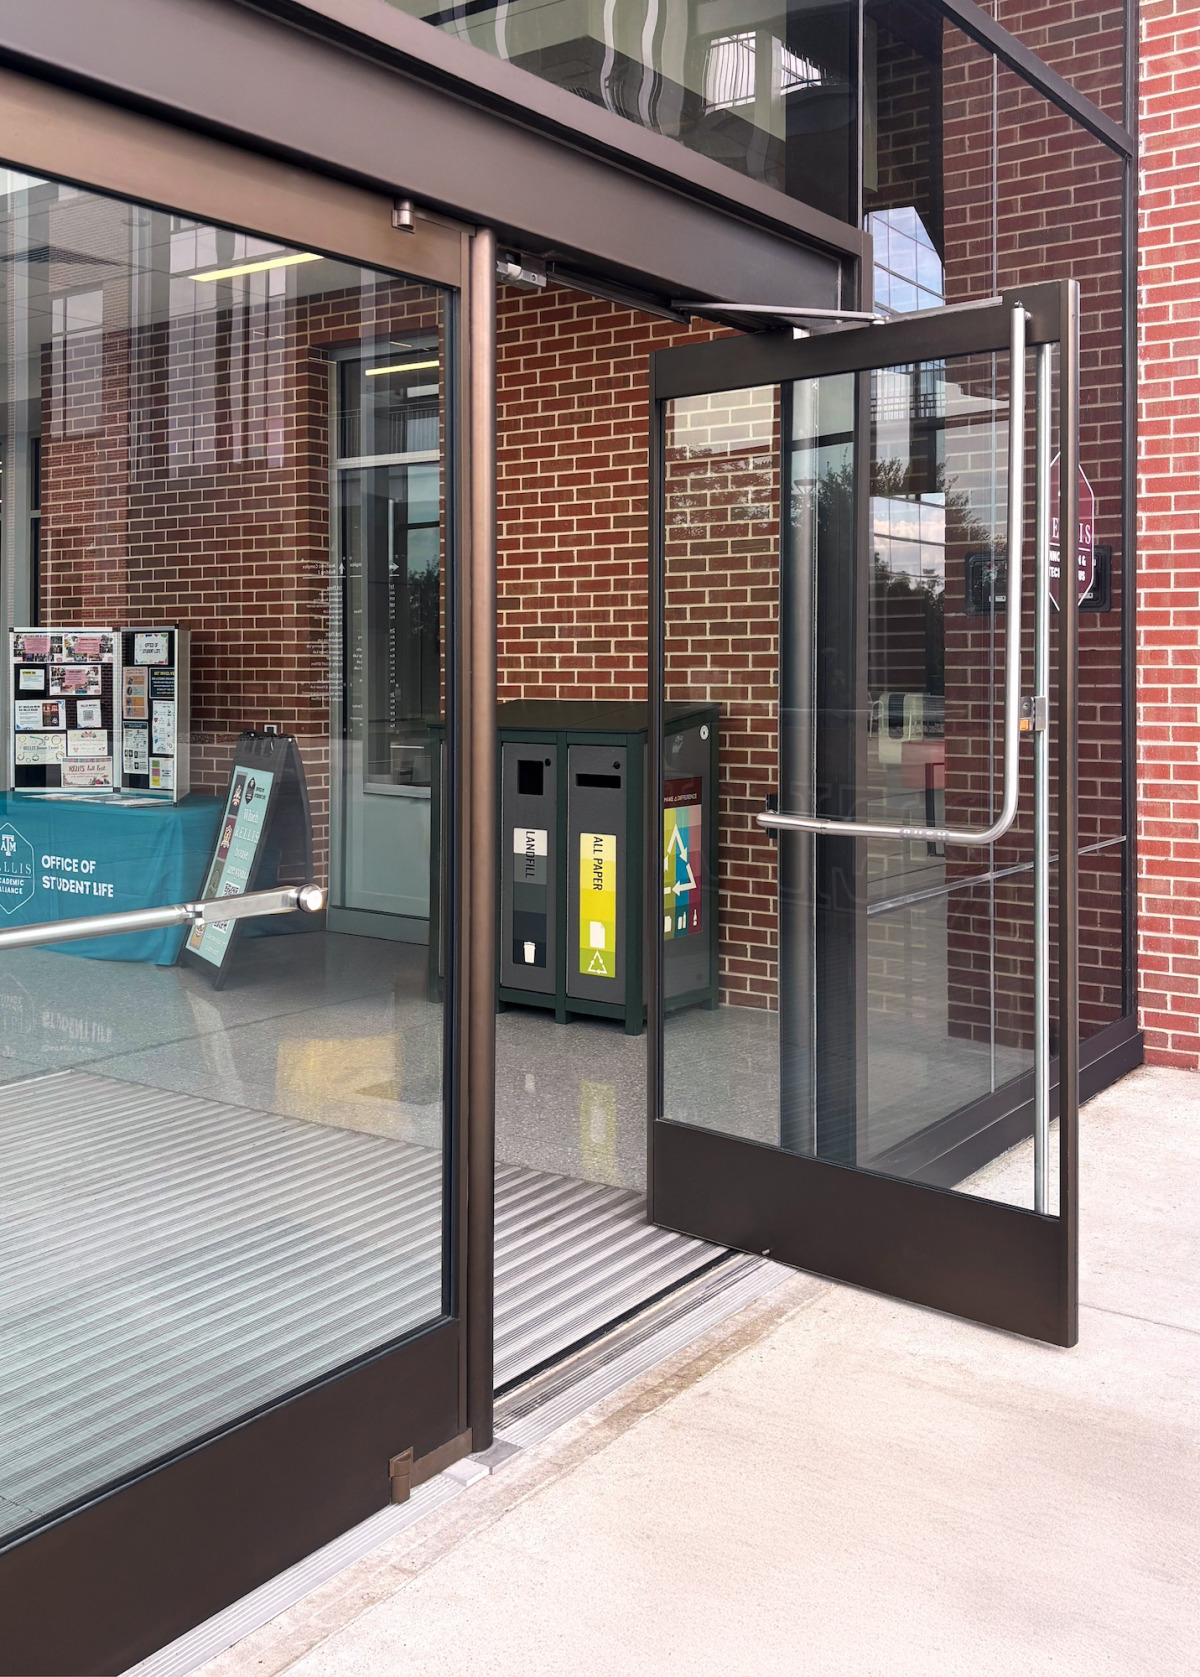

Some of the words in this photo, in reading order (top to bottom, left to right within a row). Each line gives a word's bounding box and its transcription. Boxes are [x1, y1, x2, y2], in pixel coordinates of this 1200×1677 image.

[233, 825, 260, 844] RELLIS
[525, 830, 536, 879] LANDFILL
[592, 836, 604, 855] ALL
[0, 860, 32, 875] LLIS
[41, 855, 79, 873] OFFICE
[80, 859, 97, 875] OF
[592, 857, 604, 891] PAPER
[41, 875, 91, 895] STUDENT
[92, 882, 114, 898] LIFE
